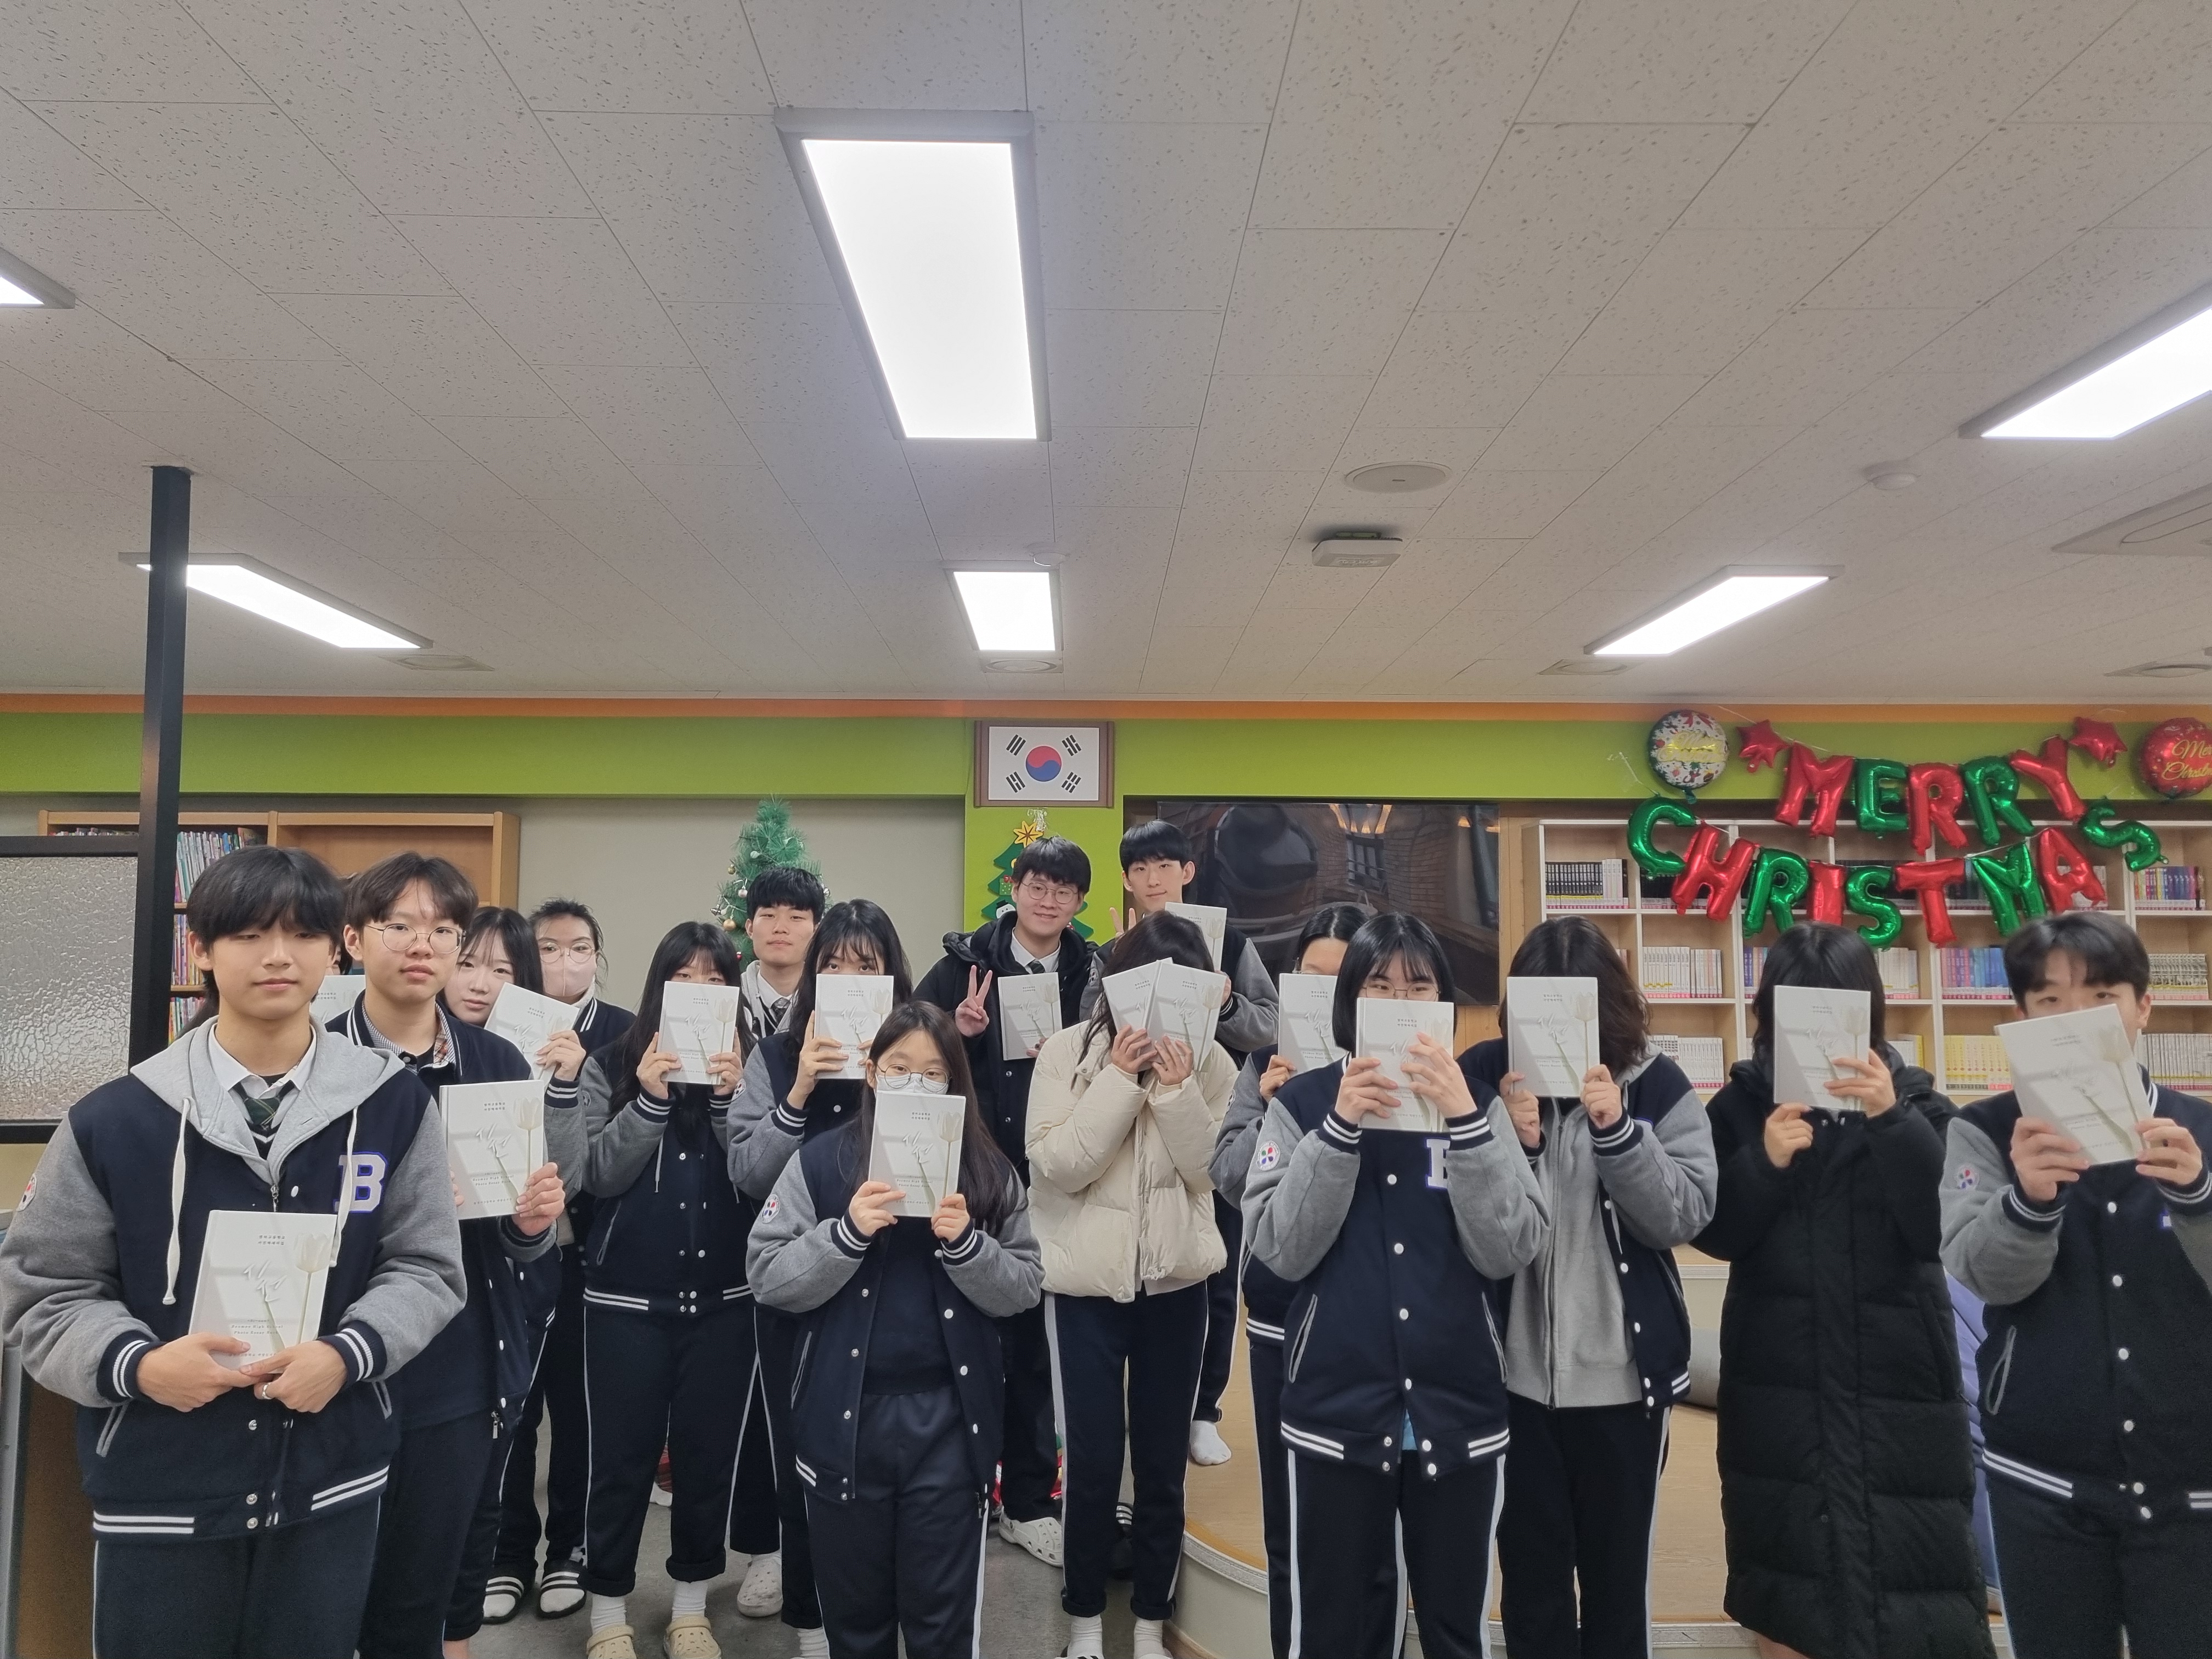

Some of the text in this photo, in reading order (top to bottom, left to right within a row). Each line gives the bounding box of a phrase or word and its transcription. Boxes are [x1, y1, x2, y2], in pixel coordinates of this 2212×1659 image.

[1774, 734, 2085, 854] MERRY
[1627, 795, 2170, 950] CHRISTMAS
[332, 1152, 387, 1214] B
